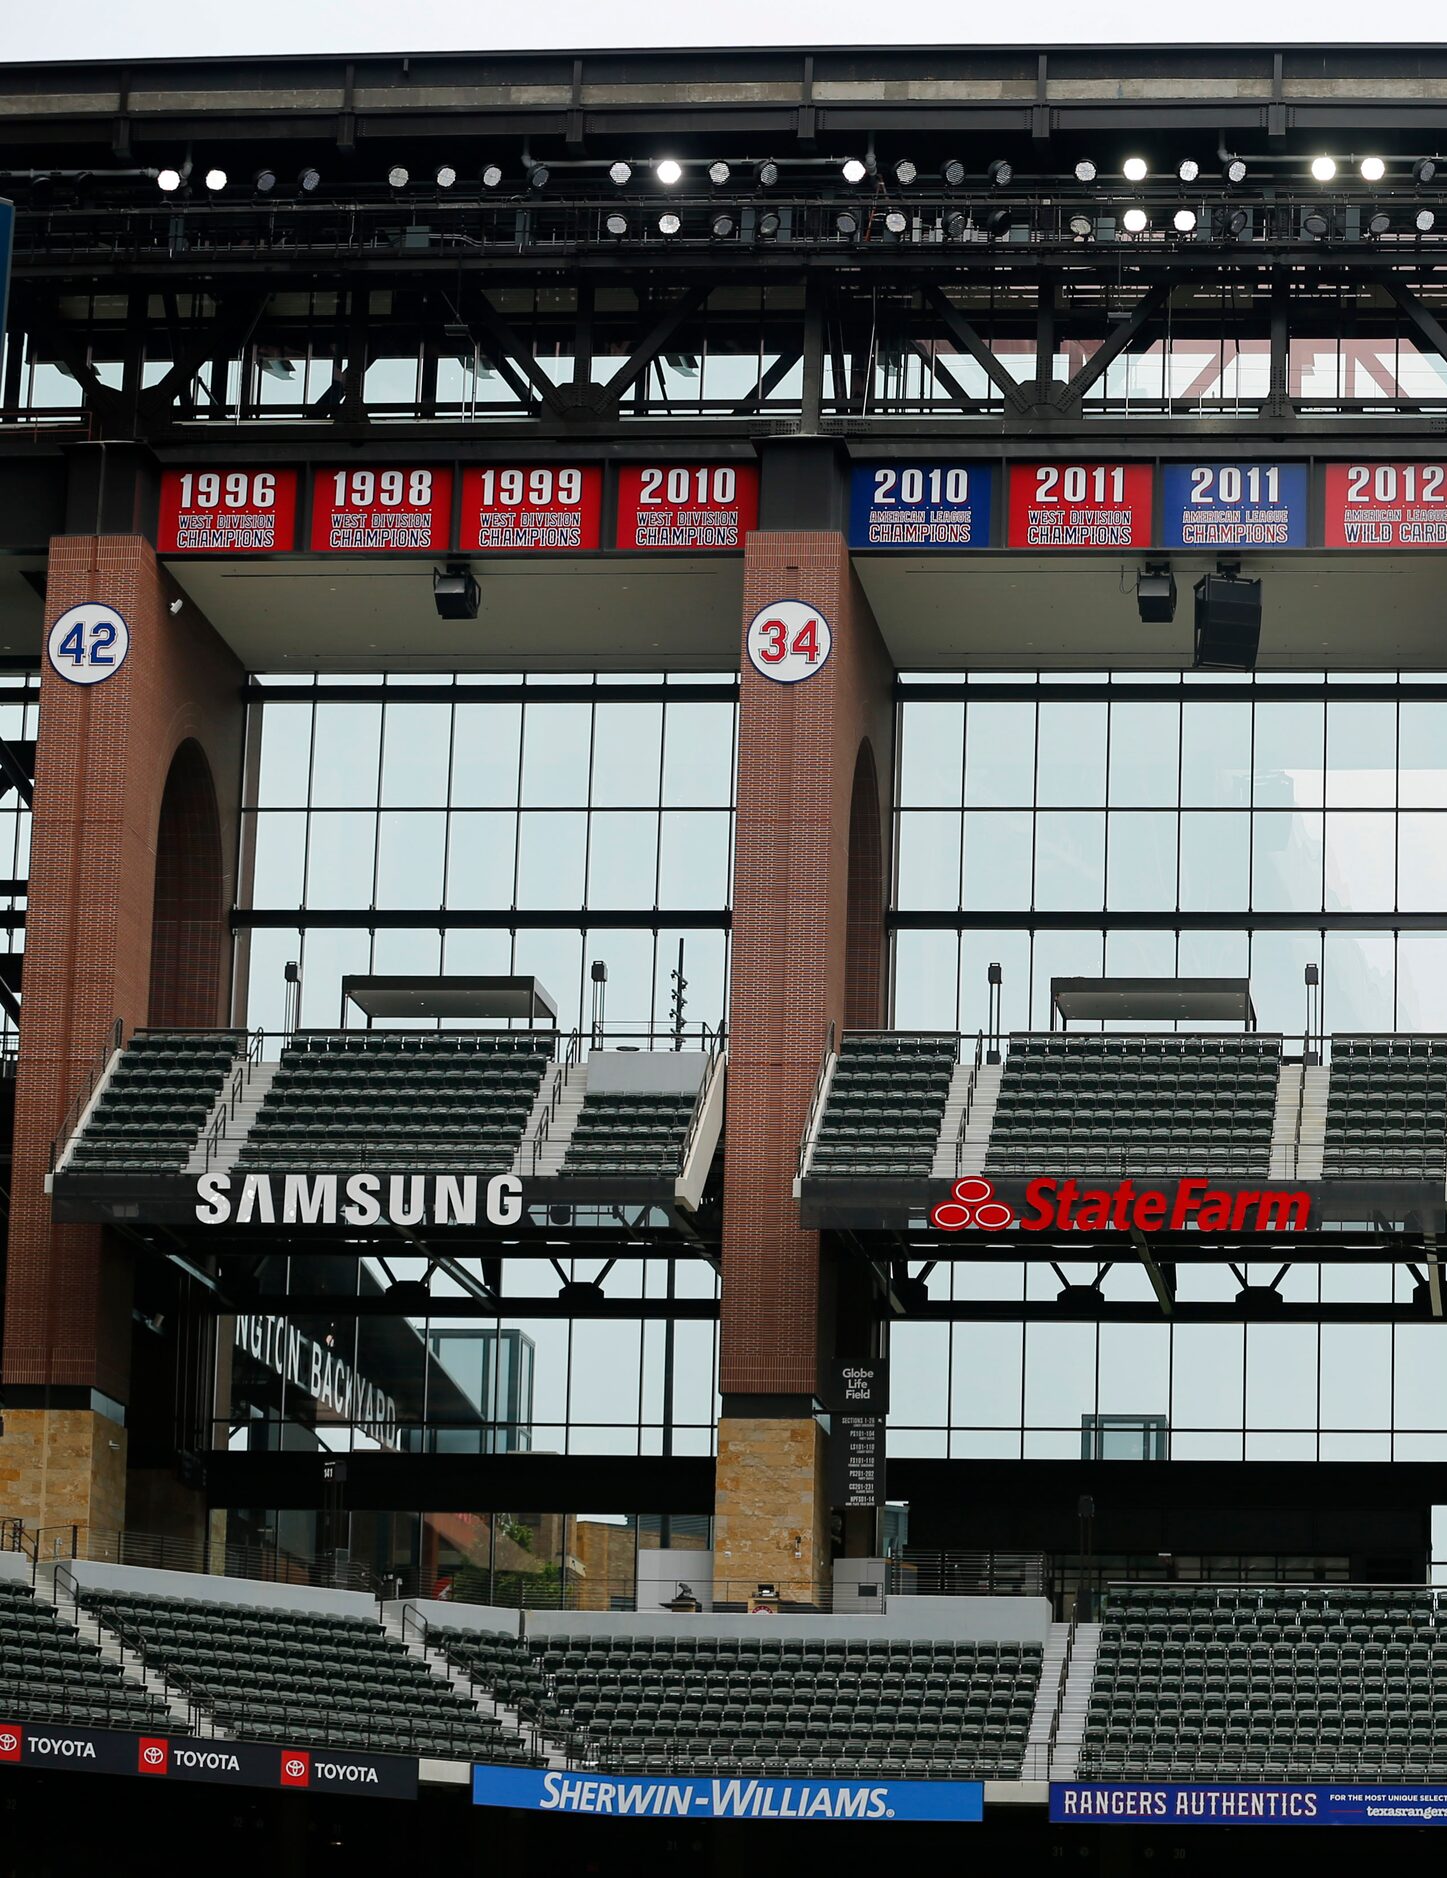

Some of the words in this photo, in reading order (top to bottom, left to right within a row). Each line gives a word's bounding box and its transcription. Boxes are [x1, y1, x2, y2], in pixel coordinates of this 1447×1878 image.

[180, 473, 276, 508] 1996
[333, 470, 432, 506] 1998
[481, 468, 582, 506] 1999
[640, 468, 736, 504] 2010
[874, 468, 969, 504] 2010
[1036, 466, 1124, 503] 2011
[1191, 467, 1280, 503] 2011
[1347, 466, 1445, 502] 2012
[179, 515, 213, 529] WEST
[216, 515, 275, 528] DIVISION
[331, 514, 367, 528] WEST
[371, 513, 431, 528] DIVISION
[480, 513, 516, 527] WEST
[520, 512, 581, 526] DIVISION
[637, 512, 672, 526] WEST
[677, 511, 738, 526] DIVISION
[869, 510, 926, 523] AMERICAN
[930, 510, 972, 523] LEAGUE
[1028, 510, 1065, 525] WEST
[1070, 510, 1132, 526] DIVISION
[1183, 510, 1241, 523] AMERICAN
[1245, 510, 1288, 523] LEAGUE
[1344, 509, 1402, 522] AMERICAN
[177, 529, 275, 548] CHAMPIONS
[330, 529, 432, 548] CHAMPIONS
[479, 528, 581, 547] CHAMPIONS
[635, 527, 738, 546] CHAMPIONS
[869, 524, 971, 543] CHAMPIONS
[1027, 526, 1132, 545] CHAMPIONS
[1182, 524, 1288, 544] CHAMPIONS
[1344, 523, 1393, 543] WILD
[58, 621, 118, 666] 42
[758, 618, 821, 664] 34
[195, 1172, 523, 1226] SAMSUNG
[842, 1368, 874, 1379] Globe
[848, 1379, 868, 1389] Life
[845, 1389, 870, 1399] Field
[27, 1736, 96, 1758] TOYOTA
[174, 1750, 240, 1771] TOYOTA
[315, 1763, 379, 1784] TOYOTA
[1064, 1790, 1167, 1814] RANGERS
[1176, 1792, 1317, 1816] AUTHENTICS
